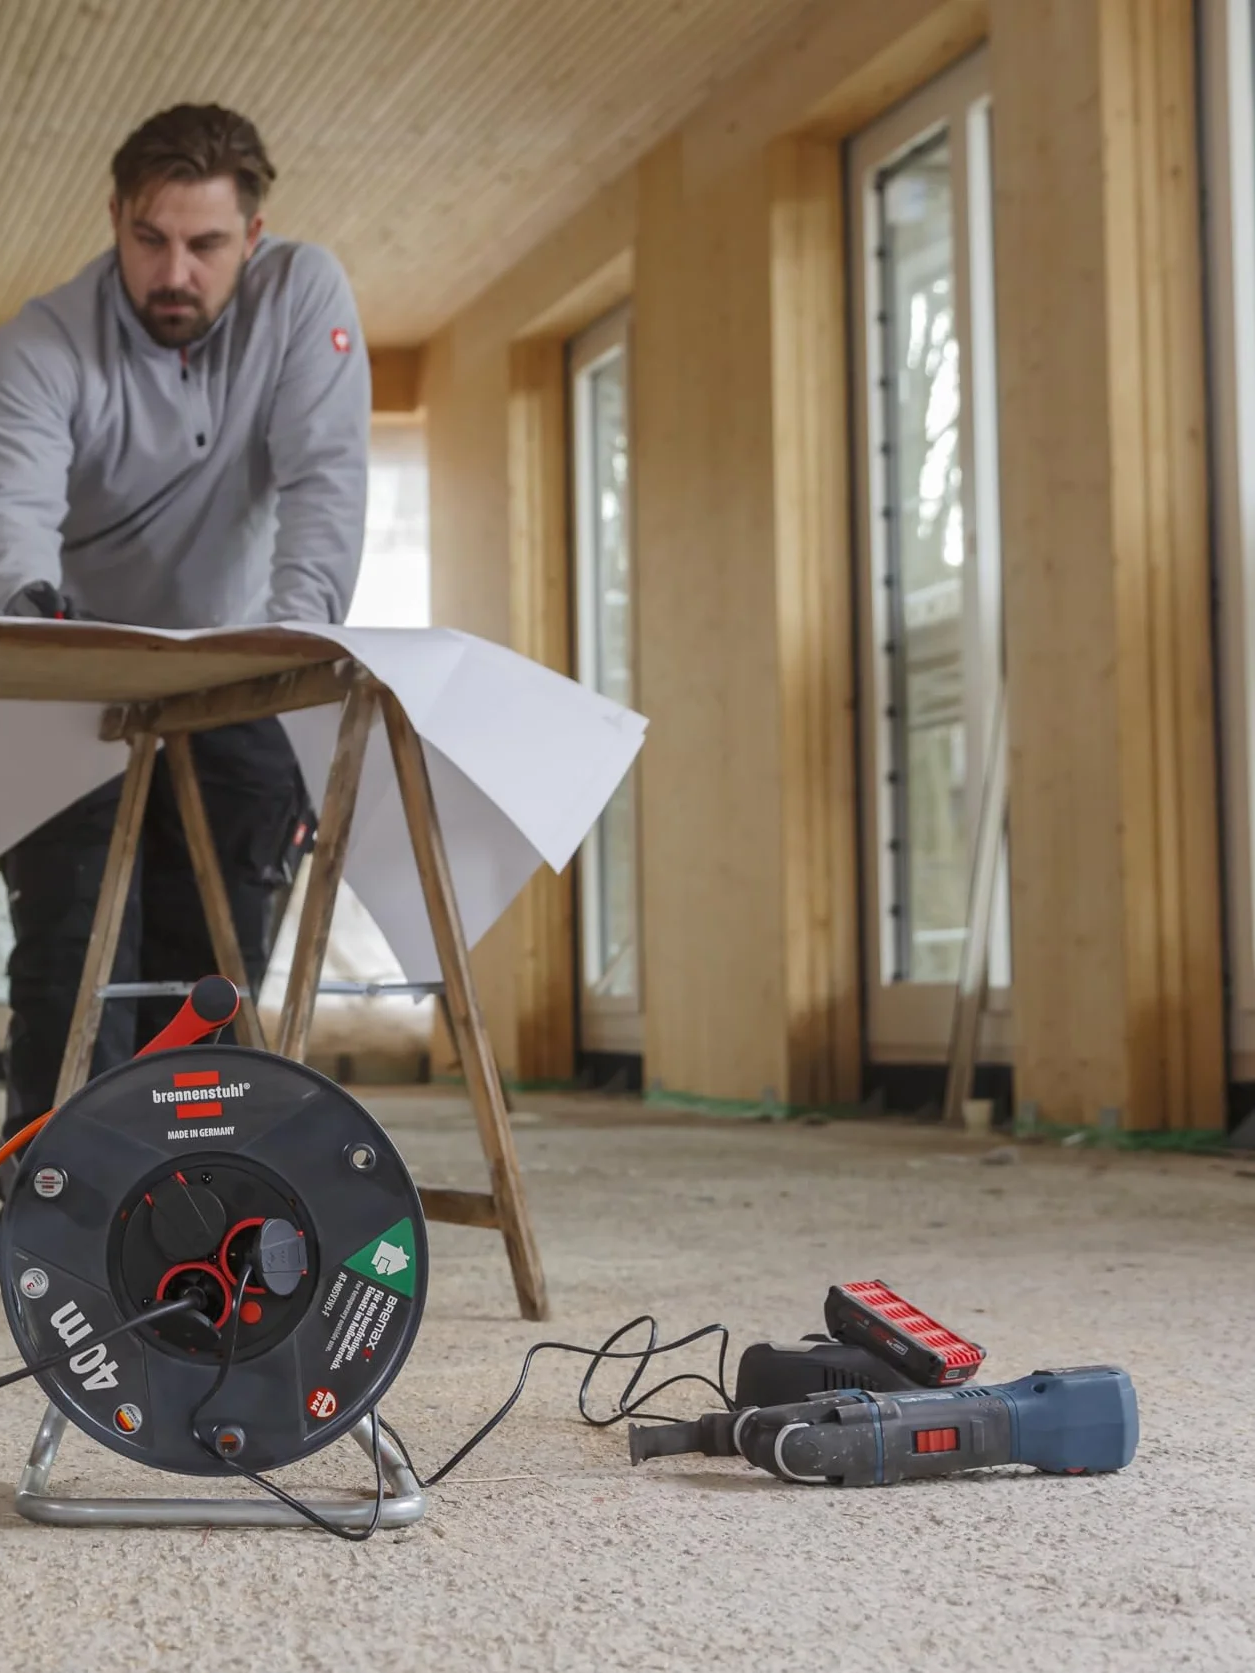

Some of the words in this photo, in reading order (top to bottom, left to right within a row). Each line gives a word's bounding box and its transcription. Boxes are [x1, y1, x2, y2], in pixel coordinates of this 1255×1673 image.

[167, 1130, 189, 1140] MADE
[190, 1129, 199, 1138] IN
[199, 1126, 235, 1138] GERMANY
[355, 1280, 364, 1290] For
[373, 1289, 385, 1303] Für
[340, 1289, 359, 1320] temporary
[358, 1285, 376, 1312] Einsatz
[366, 1302, 379, 1317] den
[50, 1300, 94, 1348] m
[353, 1311, 364, 1322] im
[331, 1319, 345, 1341] outside
[345, 1315, 372, 1361] kurzfristigen
[330, 1320, 359, 1370] Außenbereich.
[69, 1343, 119, 1391] 40
